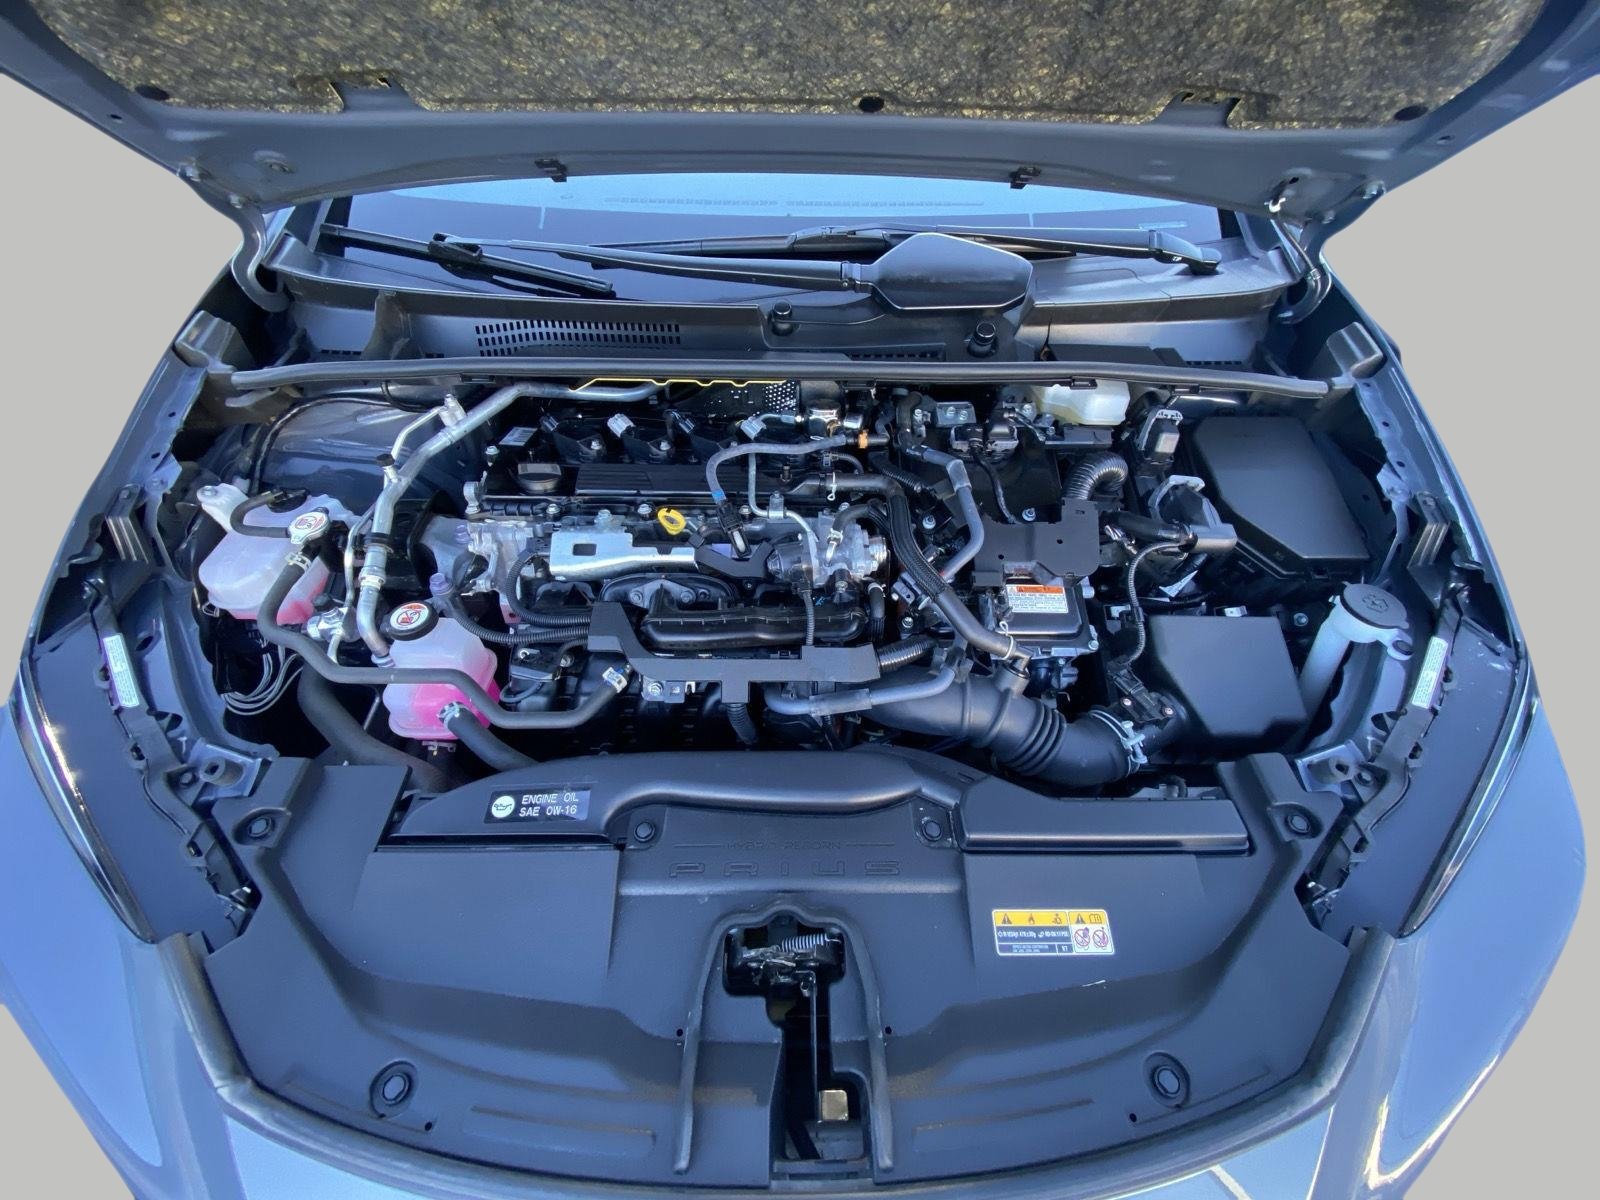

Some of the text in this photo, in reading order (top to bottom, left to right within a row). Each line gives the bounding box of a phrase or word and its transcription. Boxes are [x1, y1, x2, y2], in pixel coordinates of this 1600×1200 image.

[521, 792, 579, 805] ENGINE OIL
[519, 805, 577, 817] SAE 0W-16
[669, 861, 901, 878] PRIUS
